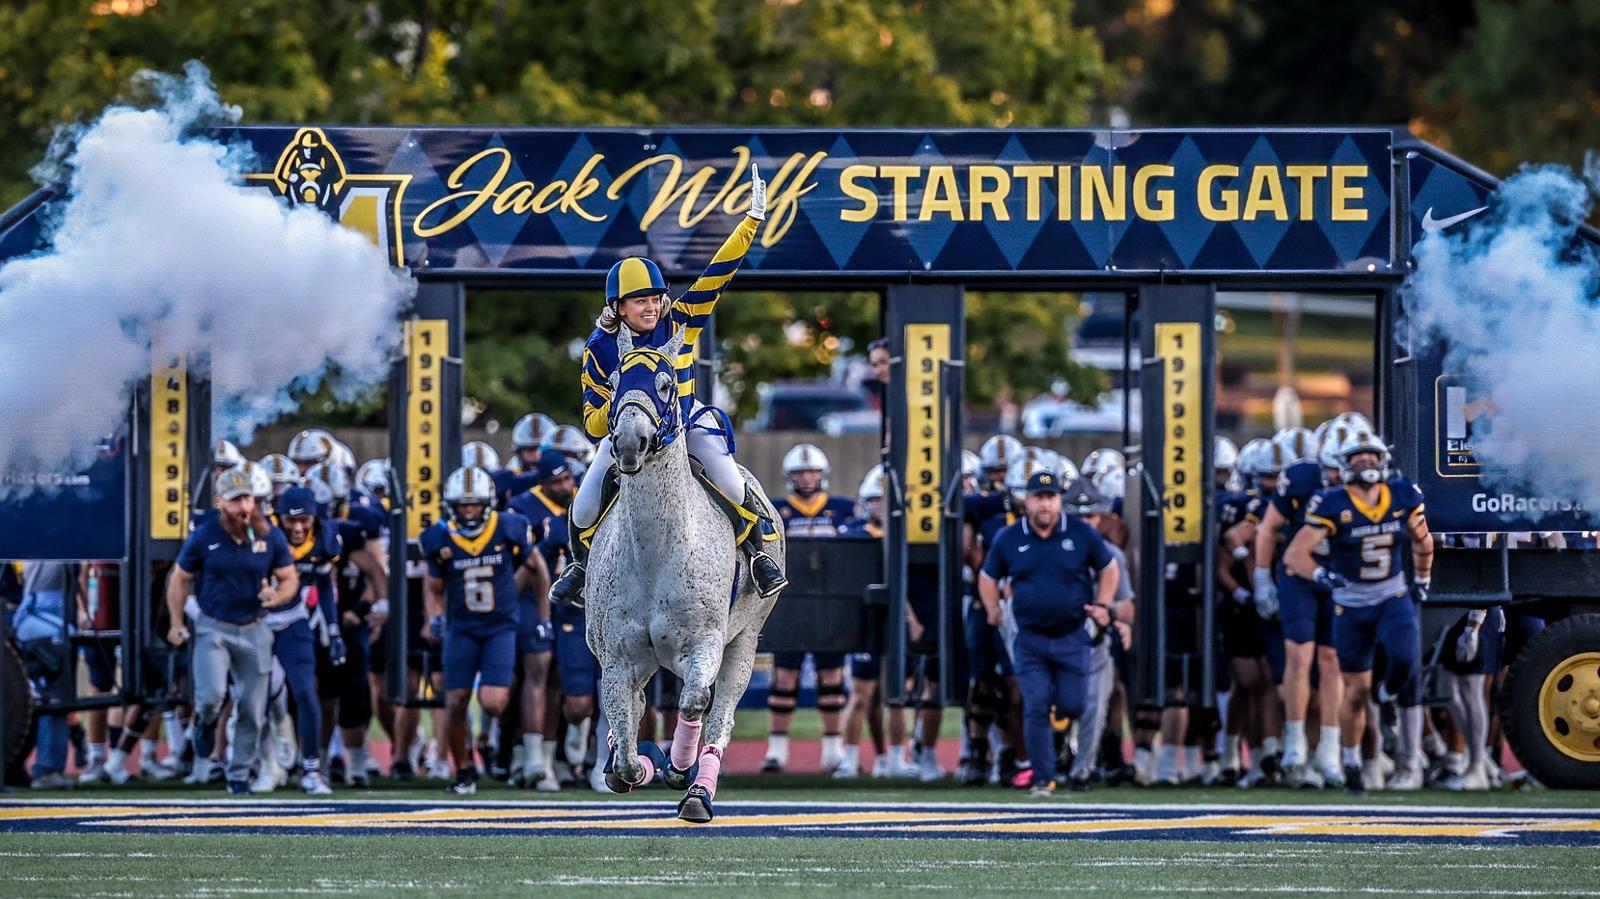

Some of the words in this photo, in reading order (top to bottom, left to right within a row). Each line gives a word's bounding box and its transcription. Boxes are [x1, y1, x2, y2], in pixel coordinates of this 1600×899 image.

[412, 147, 609, 238] Jack
[839, 164, 1176, 222] STARTING
[1197, 164, 1369, 222] GATE
[418, 329, 433, 414] 1950
[920, 335, 934, 420] 1951
[1172, 333, 1186, 418] 1979
[166, 442, 179, 526] 1986
[418, 443, 433, 528] 1995
[920, 447, 934, 533] 1996
[1172, 447, 1186, 533] 2002
[464, 566, 495, 613] 6
[1360, 534, 1393, 581] 5
